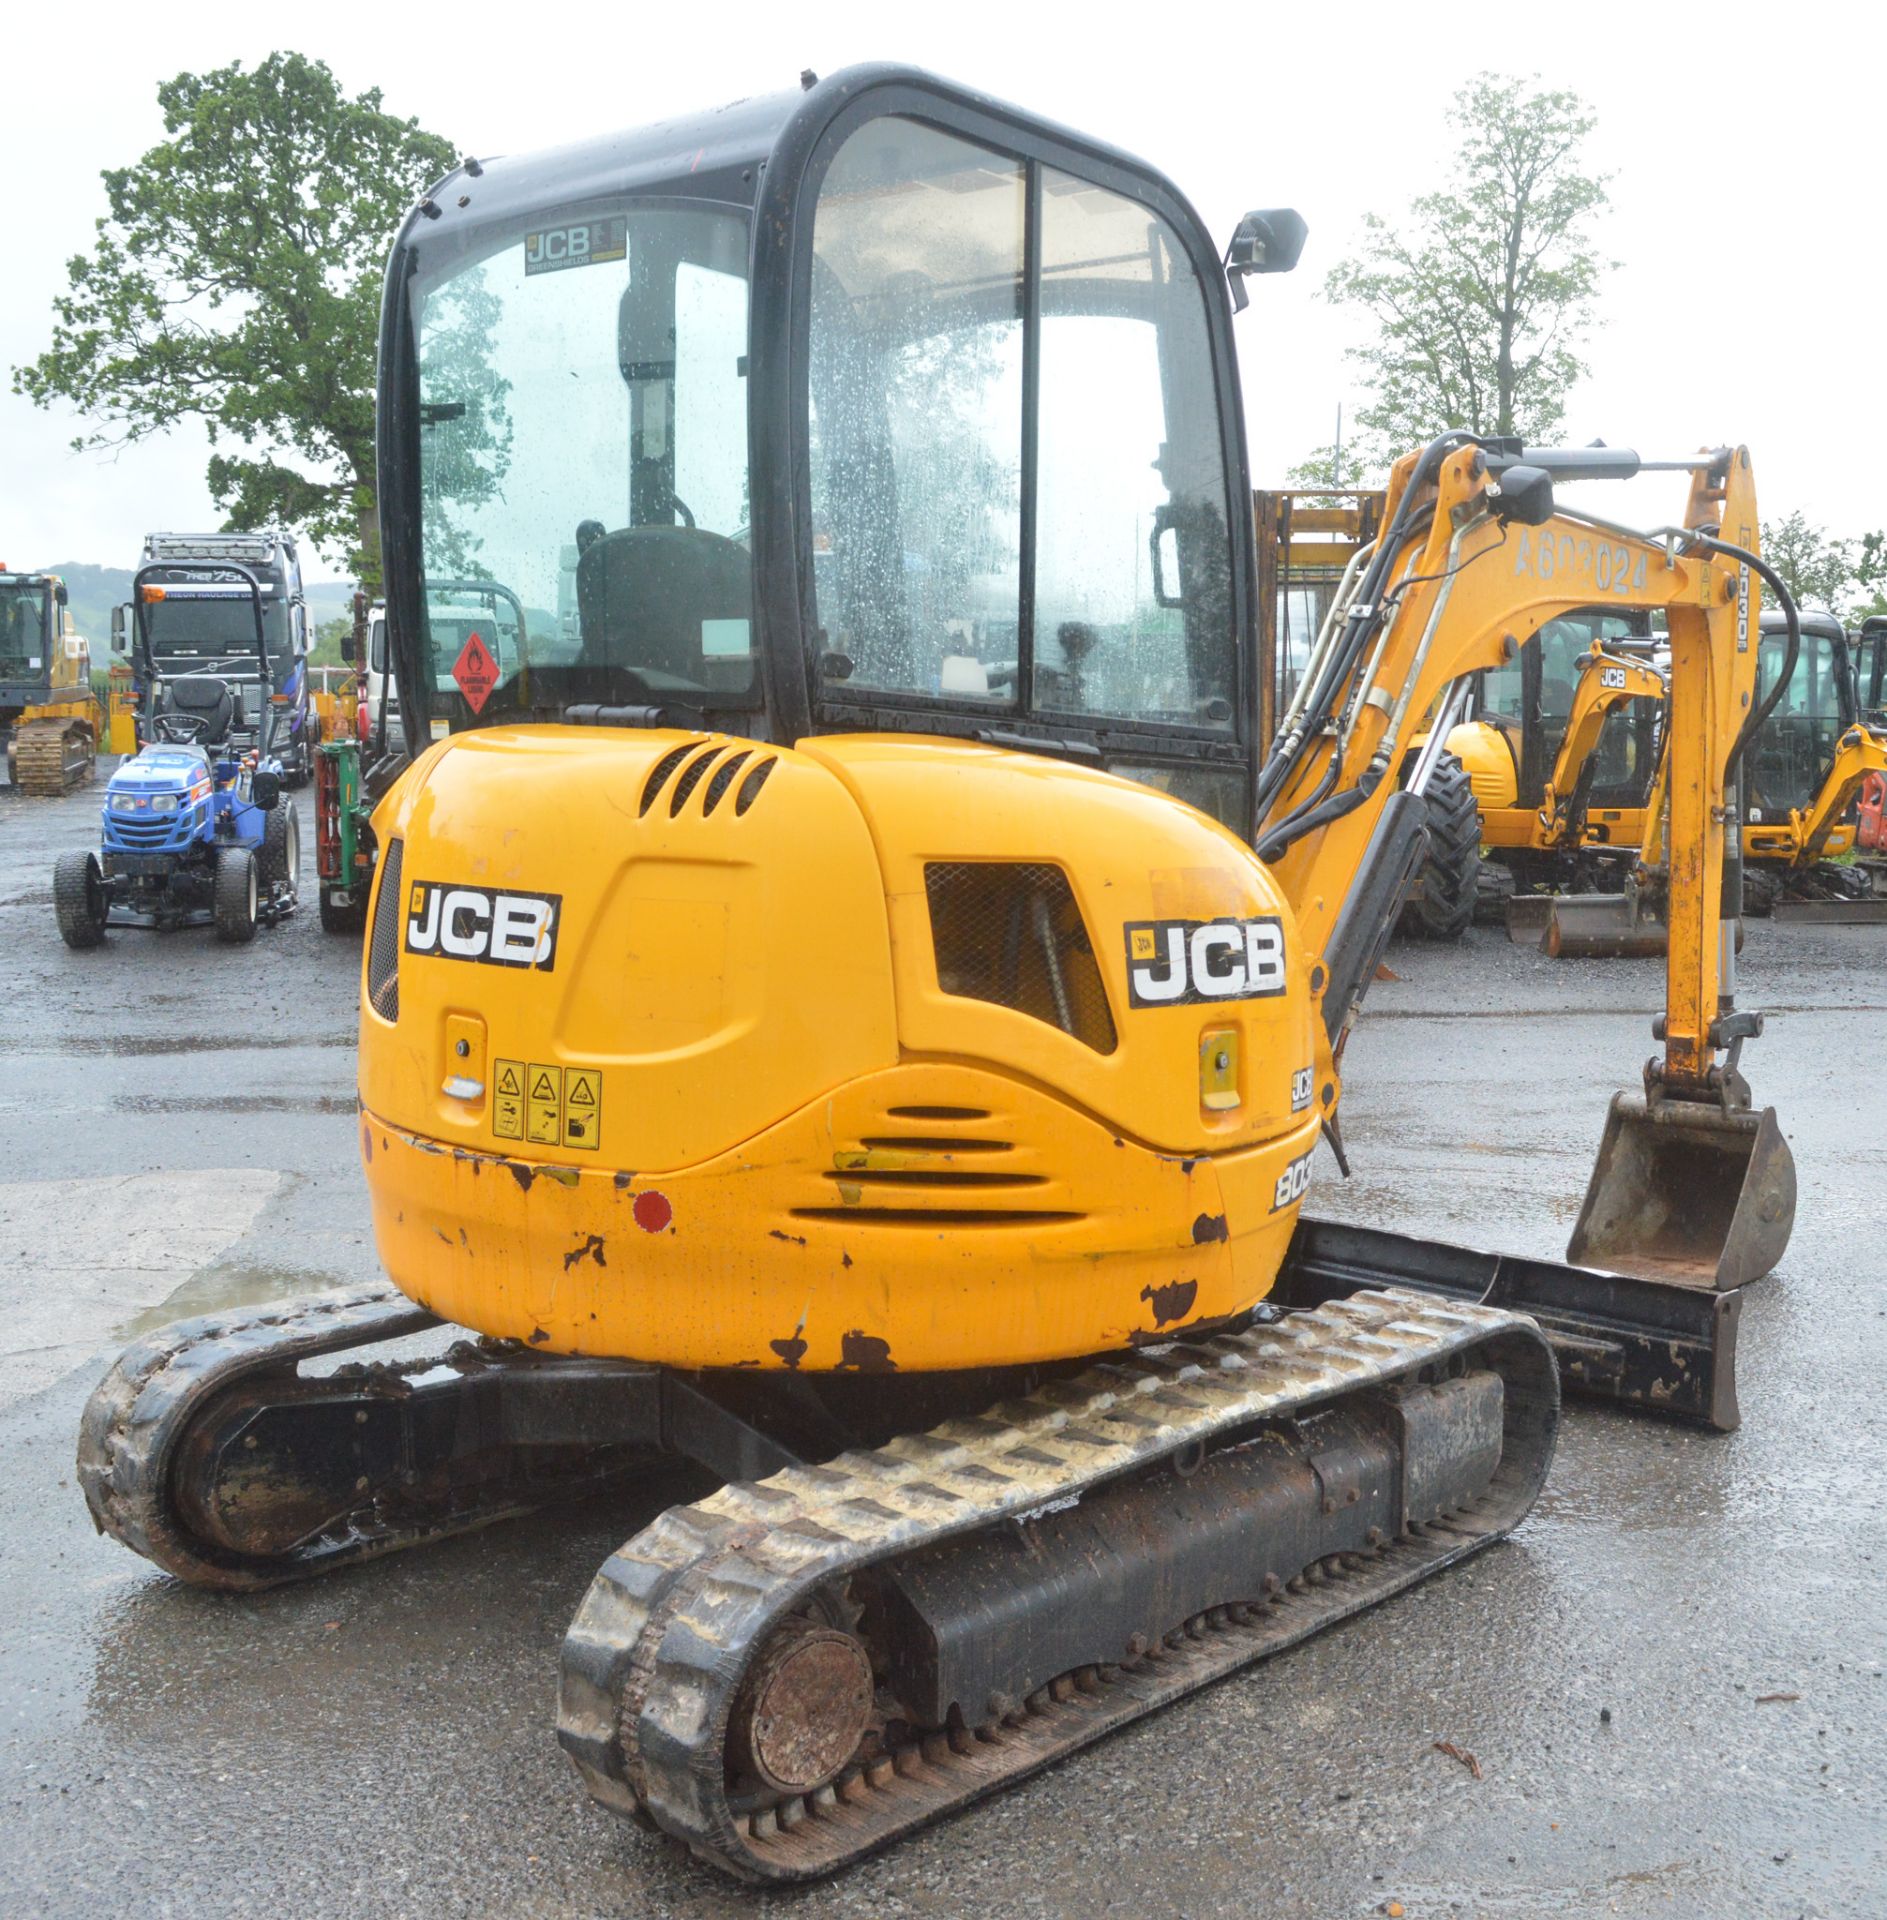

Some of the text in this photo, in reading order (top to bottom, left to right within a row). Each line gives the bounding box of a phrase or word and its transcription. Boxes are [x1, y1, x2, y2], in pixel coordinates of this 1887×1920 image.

[527, 226, 590, 263] JCB
[1601, 668, 1626, 688] JCB
[408, 888, 554, 964] JCB
[1134, 923, 1286, 1001] JCB
